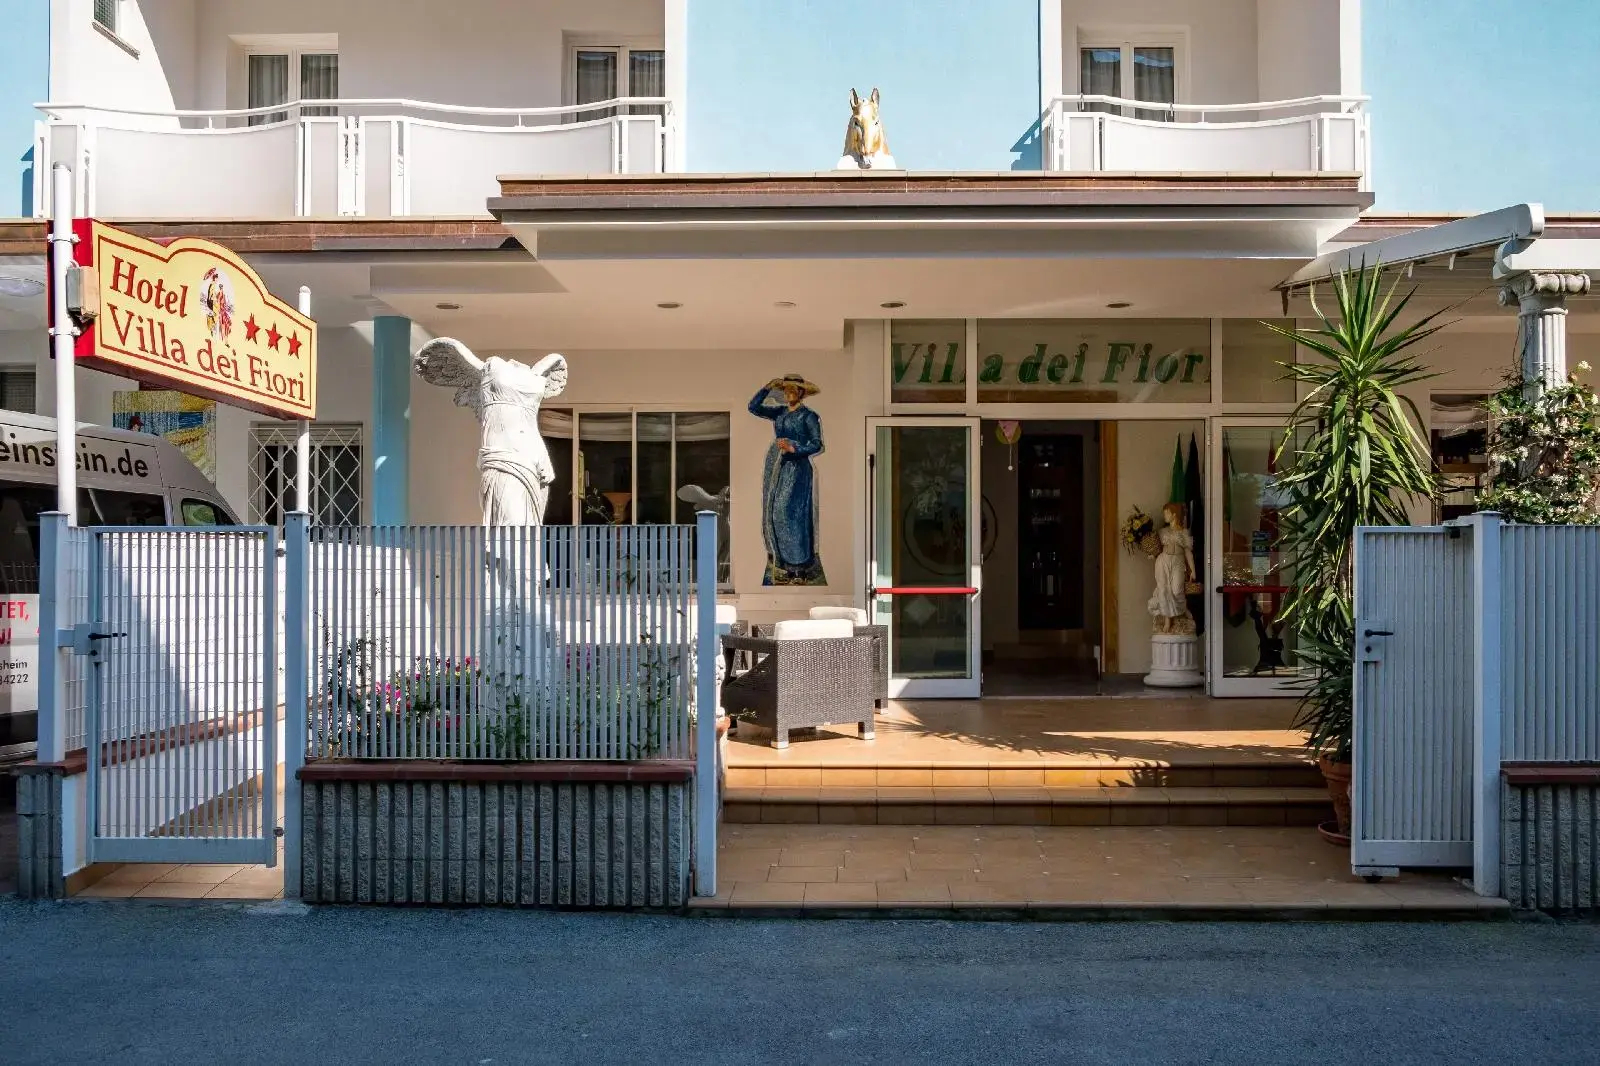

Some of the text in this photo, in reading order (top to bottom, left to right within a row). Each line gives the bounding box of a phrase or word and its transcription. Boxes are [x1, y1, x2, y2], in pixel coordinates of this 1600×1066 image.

[110, 254, 188, 318] Hotel
[107, 302, 306, 402] Villa dei Fiori
[892, 342, 1211, 384] Vila dei Fior
[0, 432, 149, 478] einsin.de
